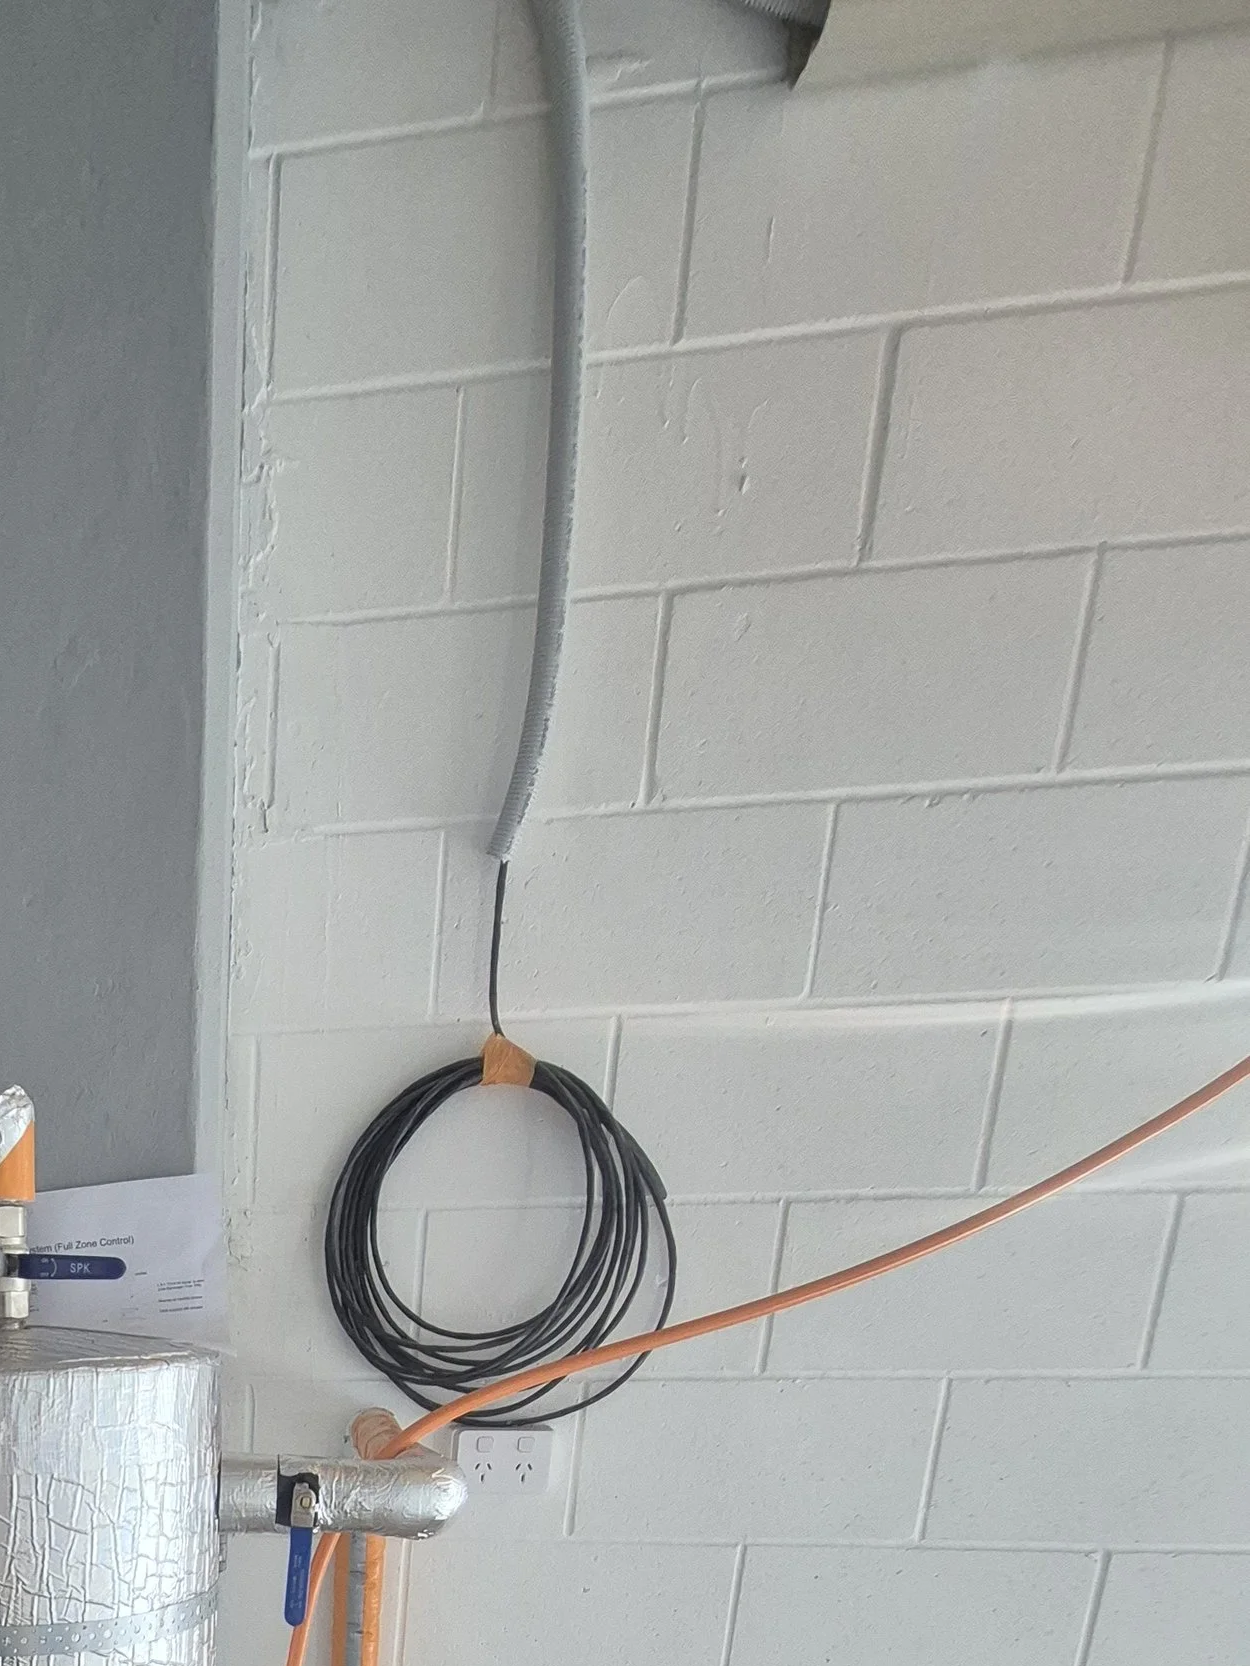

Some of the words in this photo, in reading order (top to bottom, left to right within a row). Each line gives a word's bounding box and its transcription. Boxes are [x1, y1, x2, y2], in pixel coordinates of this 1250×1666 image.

[55, 1241, 73, 1253] (Full
[75, 1240, 98, 1249] Zone
[100, 1235, 134, 1247] Control)
[70, 1262, 91, 1273] SPK
